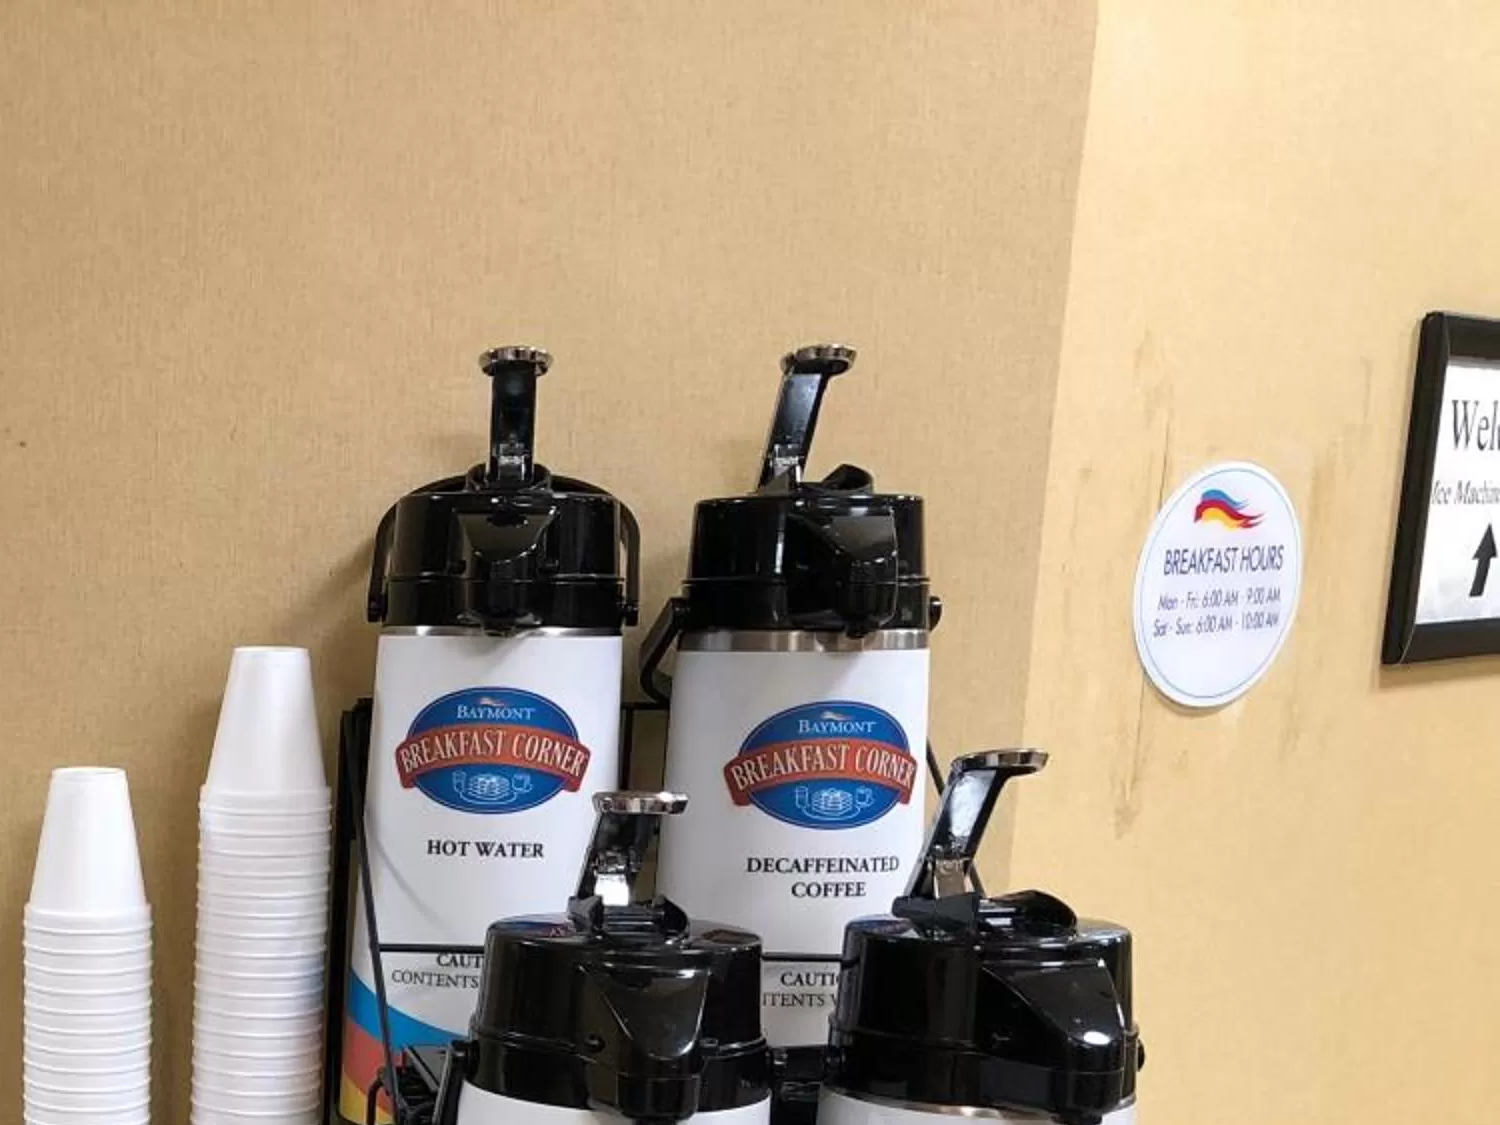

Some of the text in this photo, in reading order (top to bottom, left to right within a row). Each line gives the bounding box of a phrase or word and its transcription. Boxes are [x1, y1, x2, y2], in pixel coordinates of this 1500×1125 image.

[1452, 399, 1500, 451] Wel
[1164, 544, 1284, 576] BREAKFAST HOURS
[1202, 588, 1222, 608] 6:00
[1223, 590, 1239, 607] AM
[1266, 587, 1280, 603] AM
[1195, 614, 1216, 634] 6:00
[1217, 615, 1233, 632] AM
[1242, 611, 1264, 630] 10:00
[1266, 611, 1279, 628] AM
[456, 704, 534, 720] BAYMONT
[799, 719, 874, 734] BAYMONT
[400, 730, 584, 777] BREAKFAST CORNER
[731, 743, 916, 791] BREAKFAST CORNER
[427, 839, 544, 858] HOT WATER
[746, 856, 899, 874] DECAFFEINATED
[791, 882, 866, 898] COFFEE
[436, 952, 484, 969] CAUT
[391, 969, 479, 989] CONTENTS
[781, 971, 838, 987] CAUTI
[763, 992, 825, 1007] TENTS
